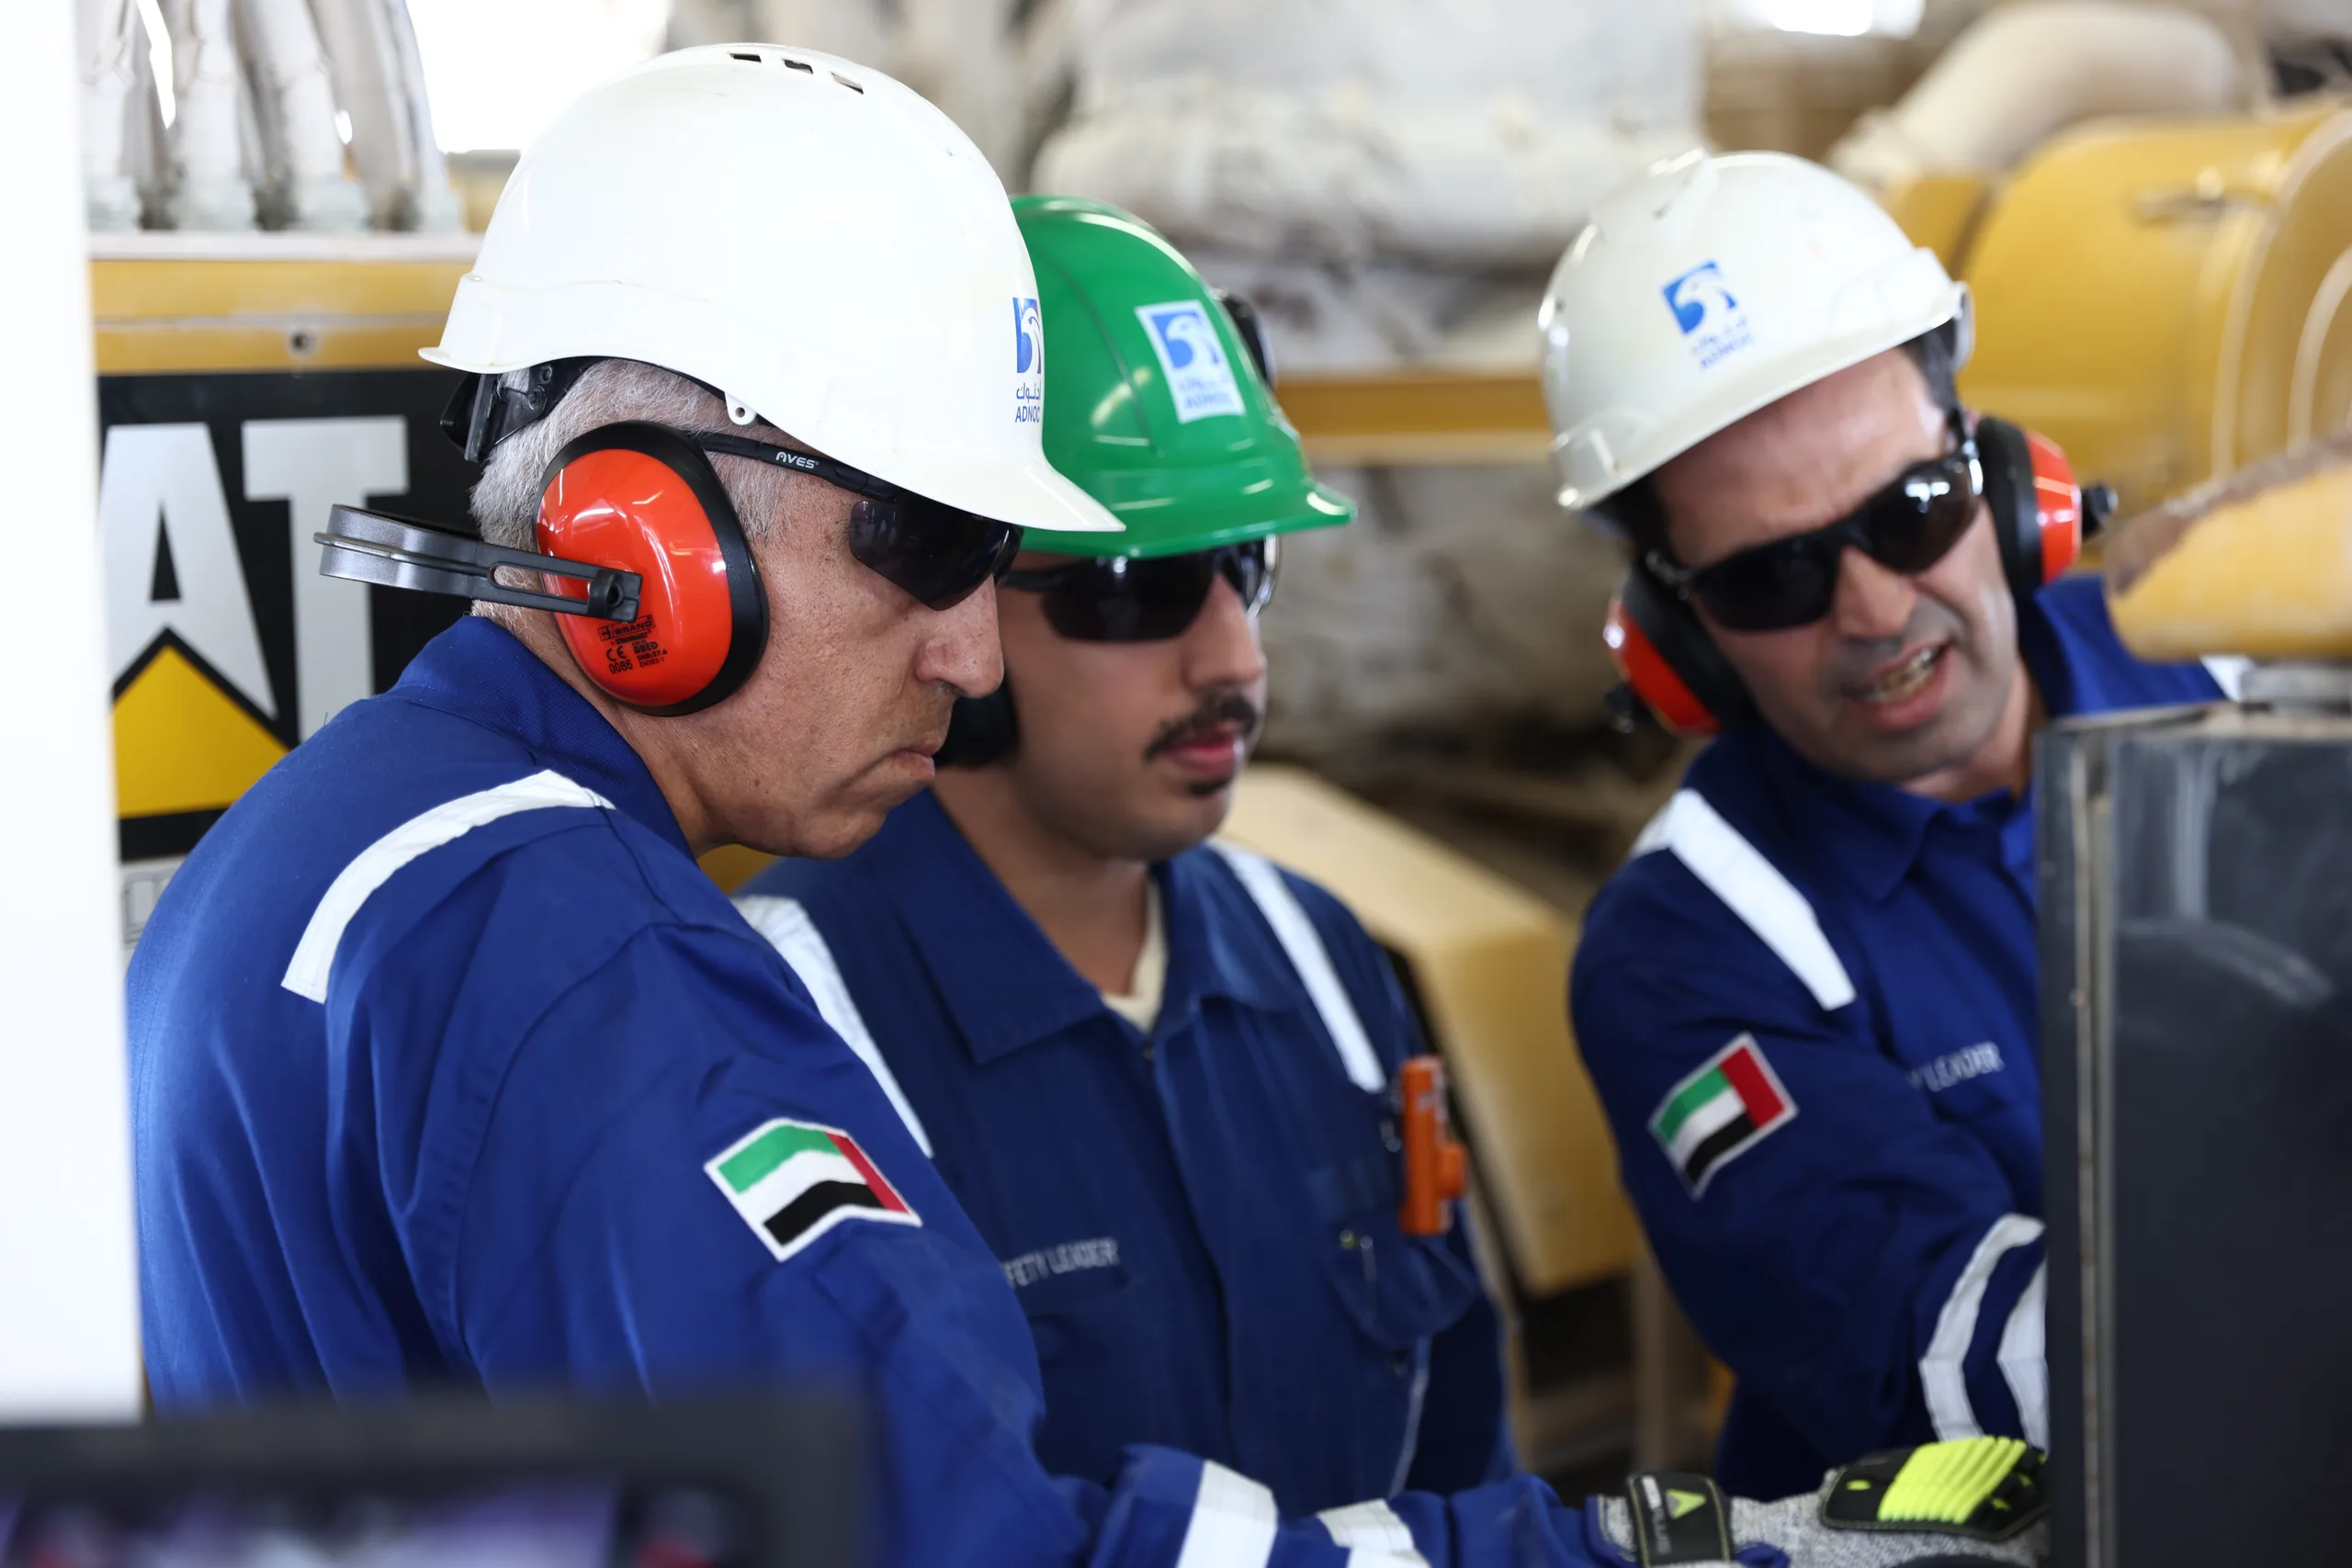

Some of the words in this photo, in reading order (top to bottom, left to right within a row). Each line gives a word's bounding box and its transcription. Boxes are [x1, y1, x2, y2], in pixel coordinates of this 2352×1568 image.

[1015, 405, 1040, 423] ADNOC
[98, 416, 409, 743] AT
[606, 646, 627, 661] CE
[608, 660, 633, 674] 0086
[1002, 1251, 1049, 1287] FETY
